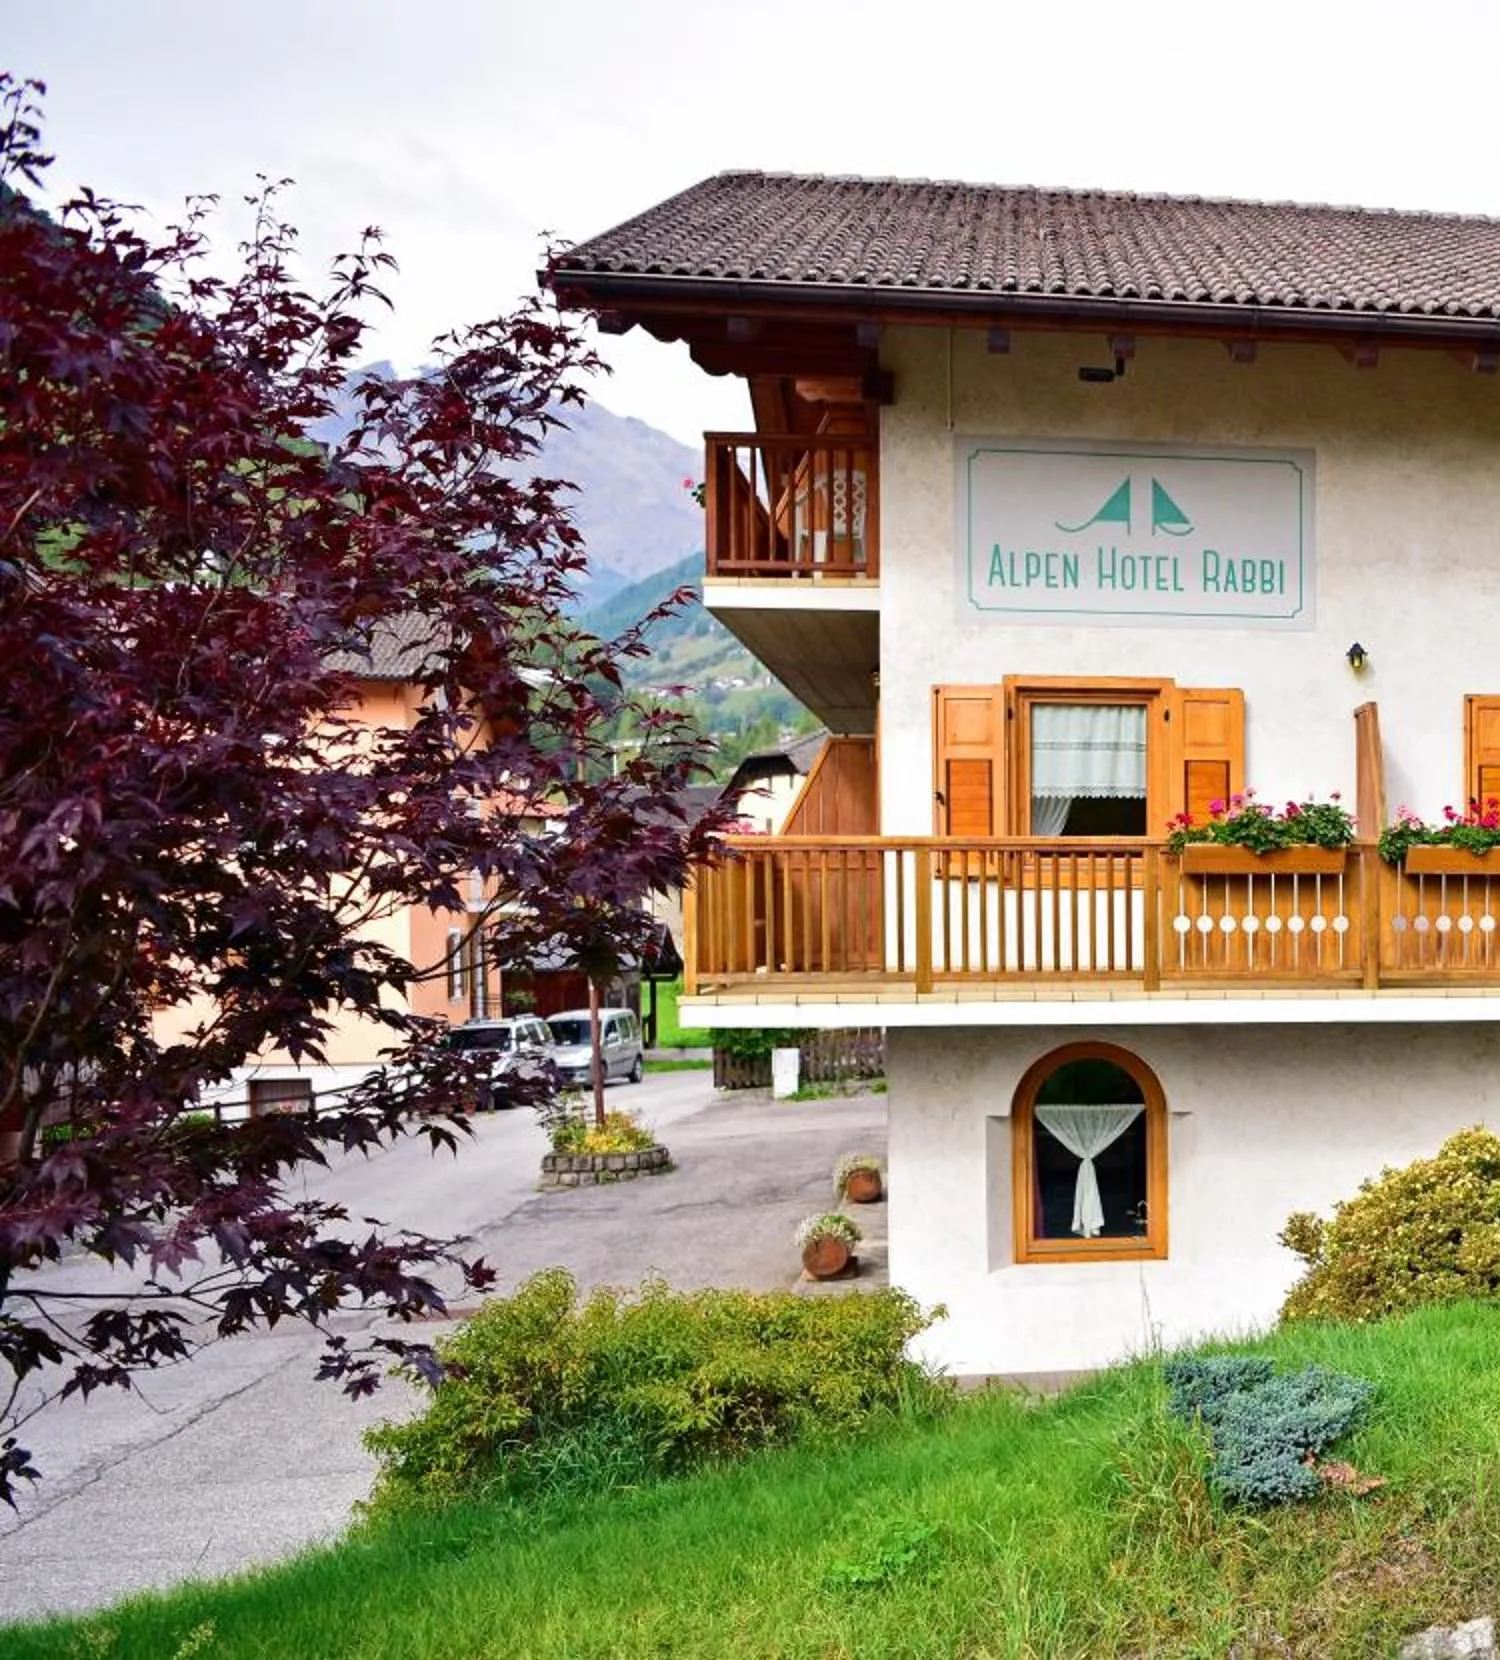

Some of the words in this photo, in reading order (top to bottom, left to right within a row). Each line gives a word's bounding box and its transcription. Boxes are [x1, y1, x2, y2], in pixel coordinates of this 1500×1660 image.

[988, 544, 1079, 589] ALPEN
[1098, 547, 1184, 592] HOTEL
[1203, 550, 1284, 595] RABBI
